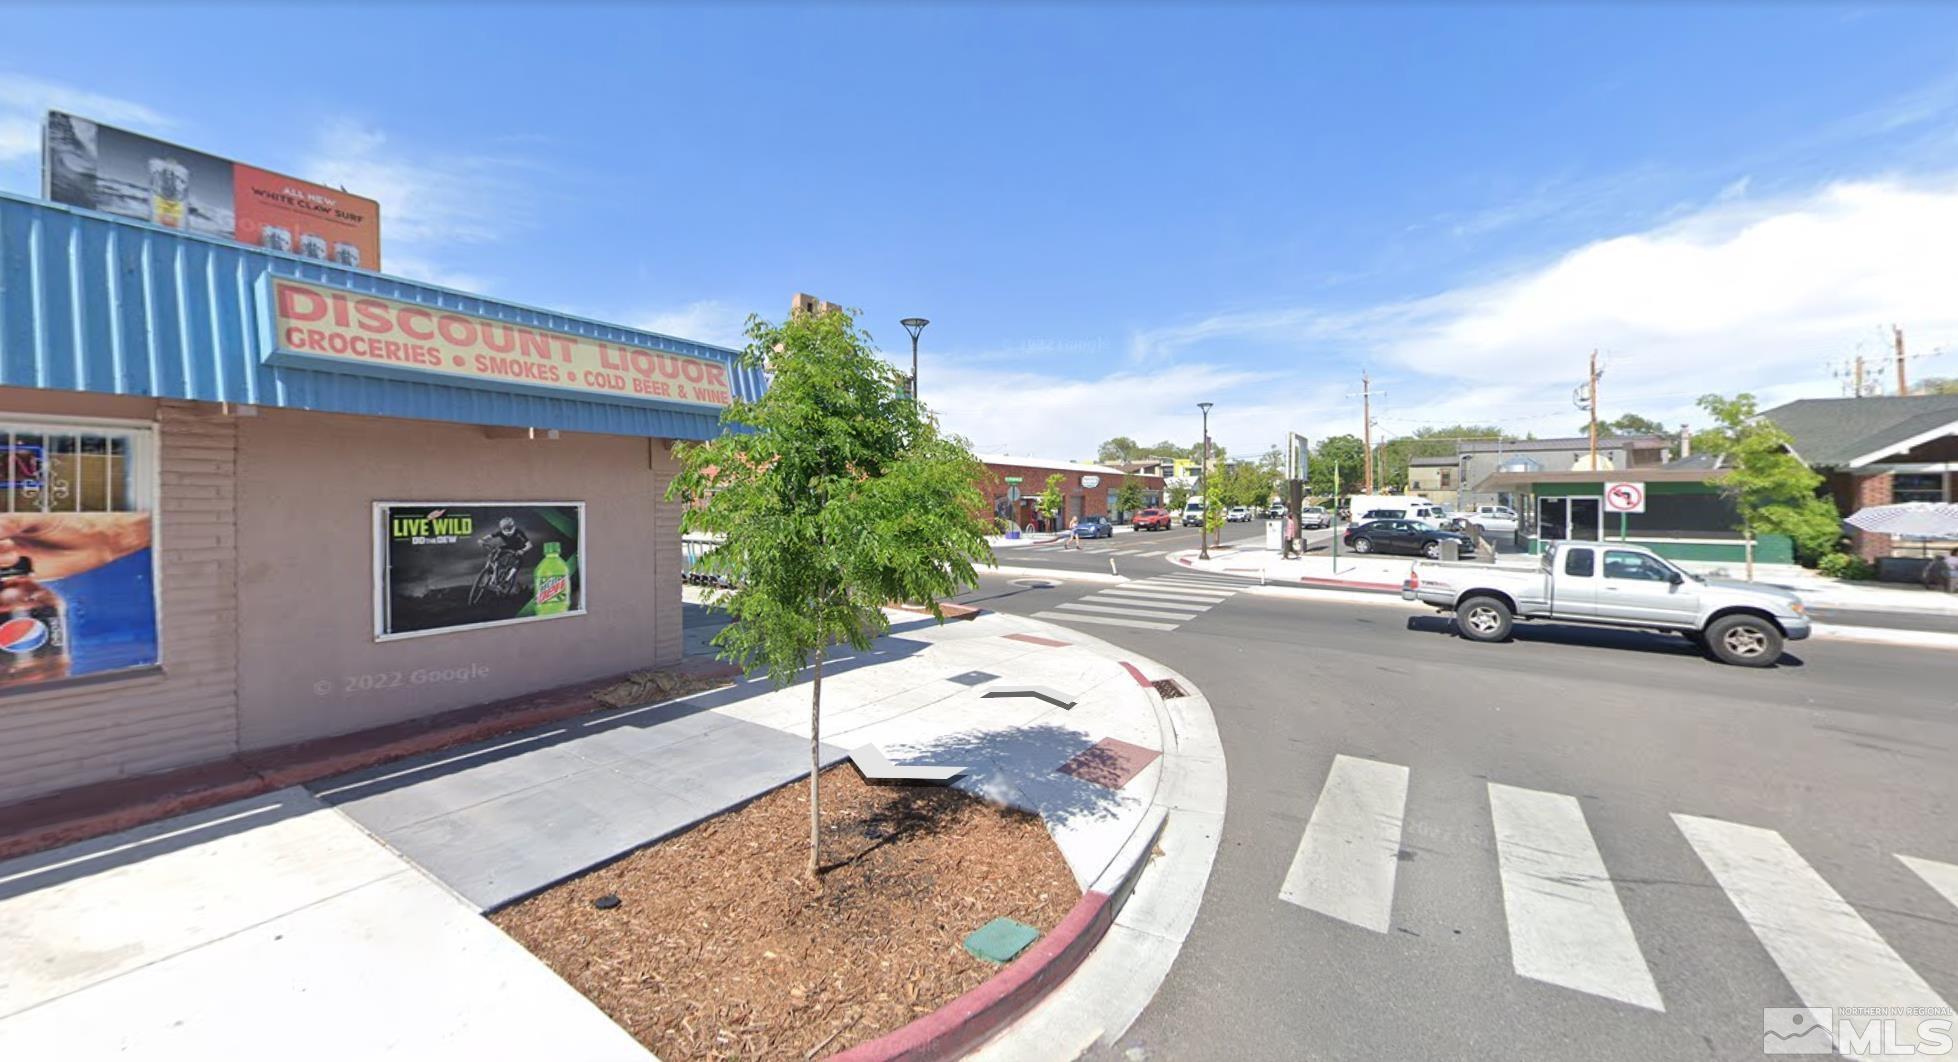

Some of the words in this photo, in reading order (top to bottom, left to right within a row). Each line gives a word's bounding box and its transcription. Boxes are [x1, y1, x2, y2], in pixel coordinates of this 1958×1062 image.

[251, 186, 296, 206] WHITE
[297, 199, 332, 215] CLAW
[335, 209, 364, 223] SURF
[282, 187, 304, 198] ALL
[307, 193, 337, 206] NEW
[276, 282, 579, 364] DISCOUNT
[600, 343, 728, 388] LIQUOR
[286, 326, 443, 367] GROCERIES
[475, 353, 561, 383] SMOKES
[584, 369, 626, 391] COLD
[632, 378, 671, 398] BEER
[677, 385, 688, 399] &
[693, 386, 730, 405] WINE
[393, 518, 429, 537] LIVE
[433, 518, 472, 535] WILD
